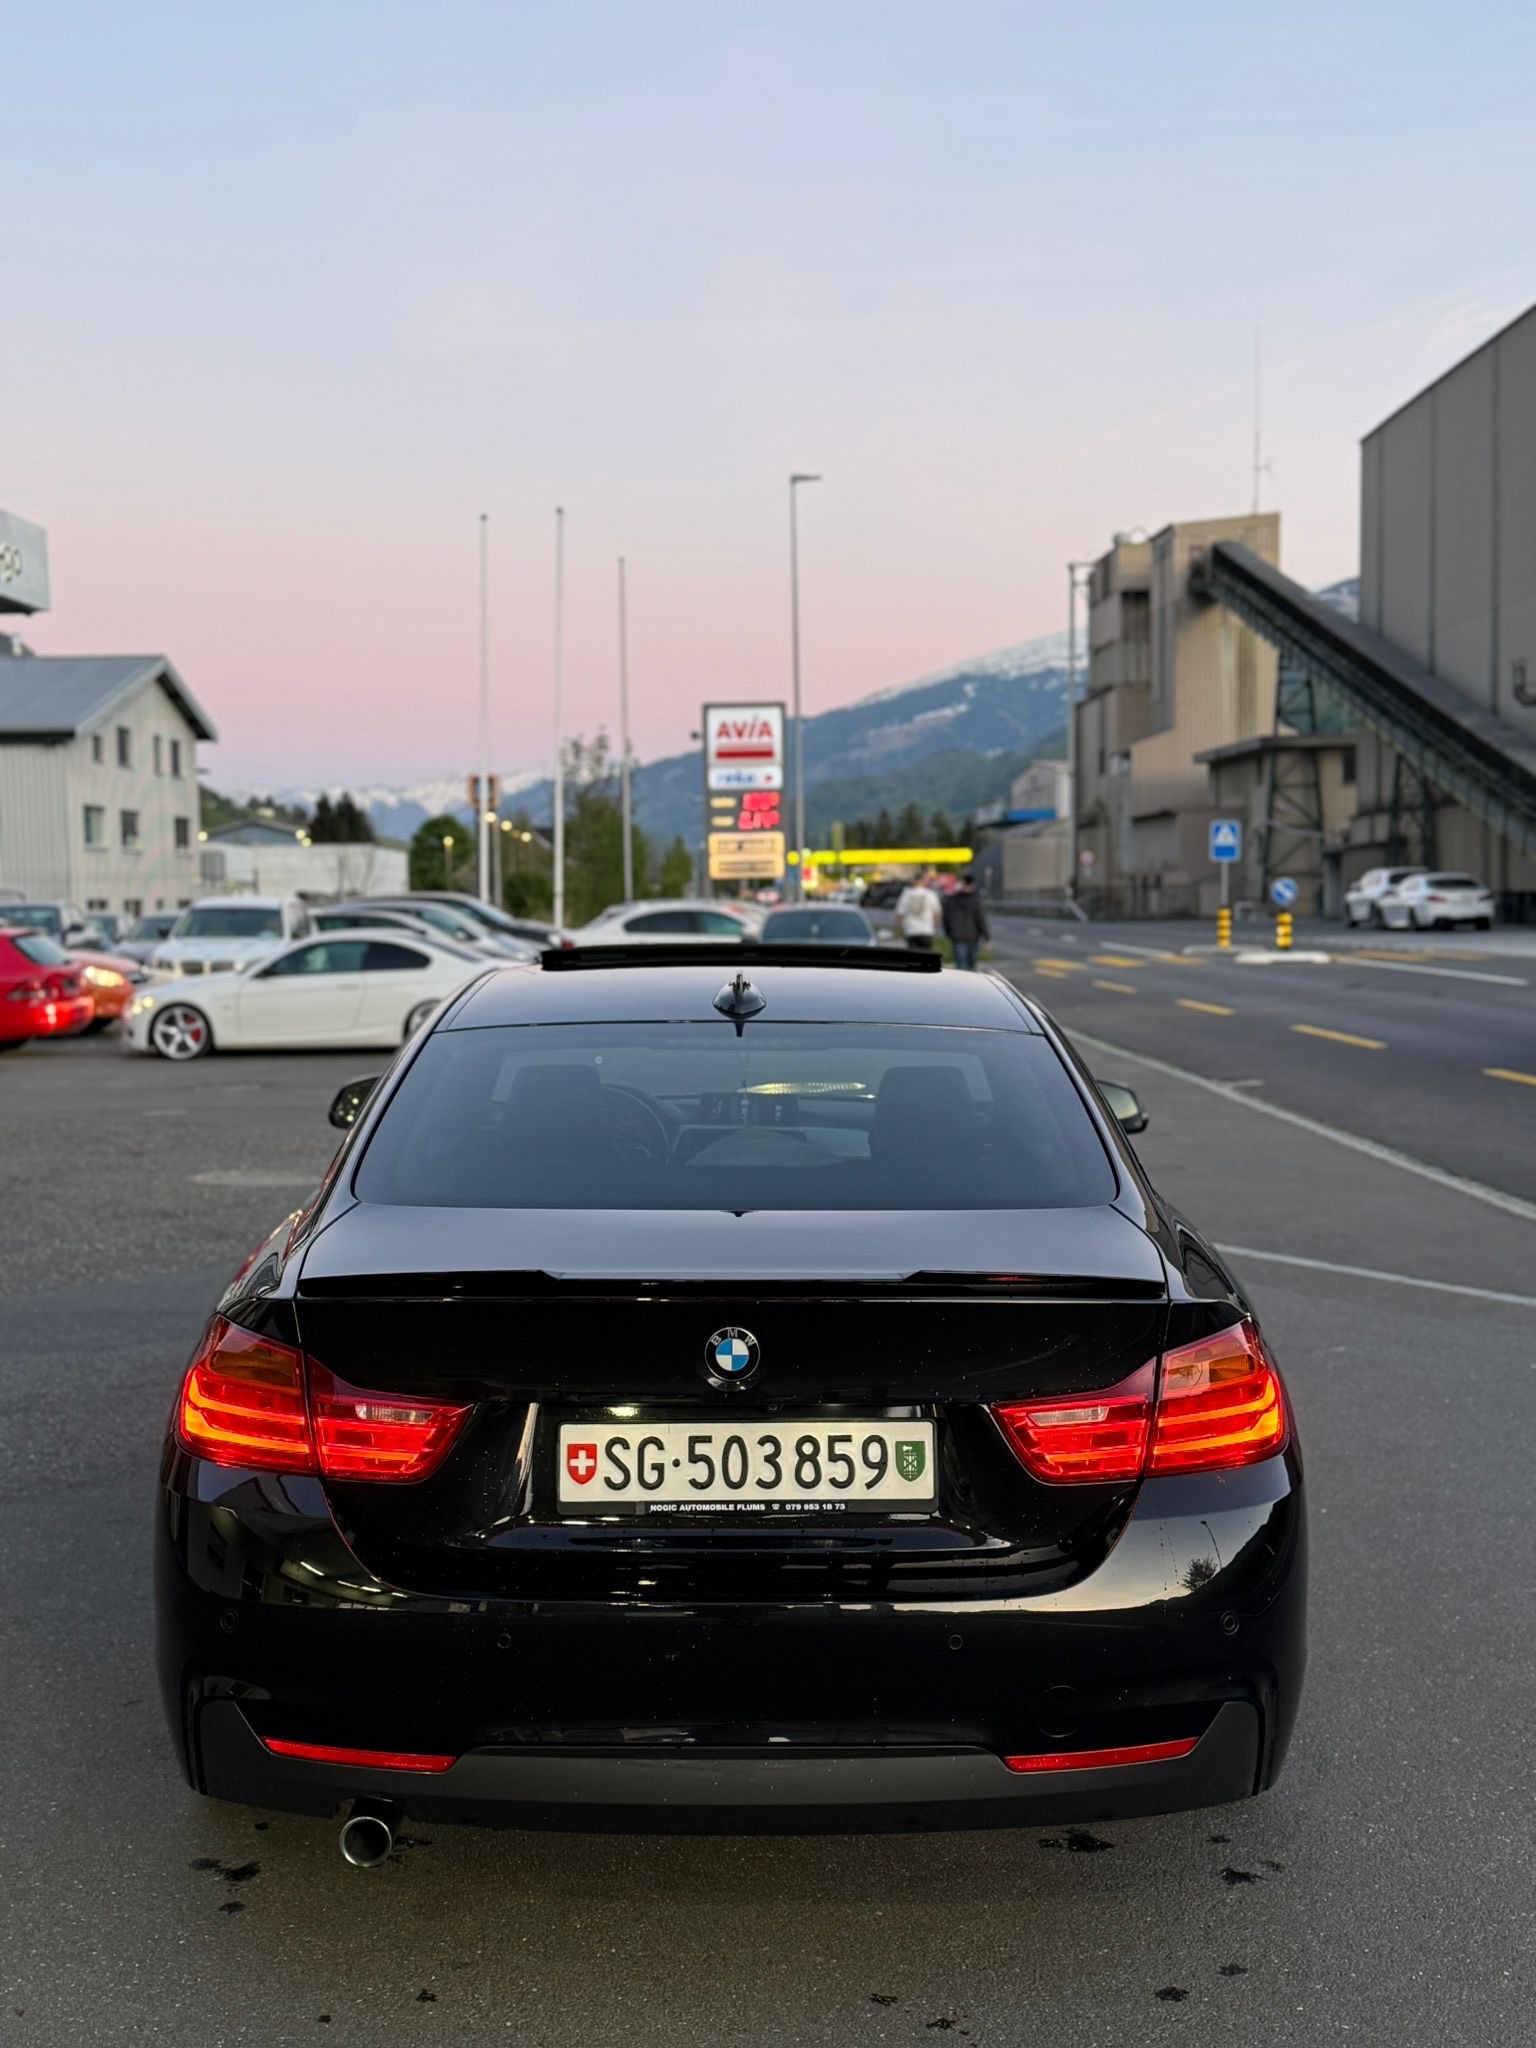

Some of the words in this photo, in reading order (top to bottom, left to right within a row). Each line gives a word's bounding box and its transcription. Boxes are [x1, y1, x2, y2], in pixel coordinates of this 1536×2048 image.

[717, 716, 773, 740] AVIA
[710, 1329, 757, 1346] BMW
[736, 1503, 766, 1511] FLUMS
[834, 1503, 846, 1511] 73
